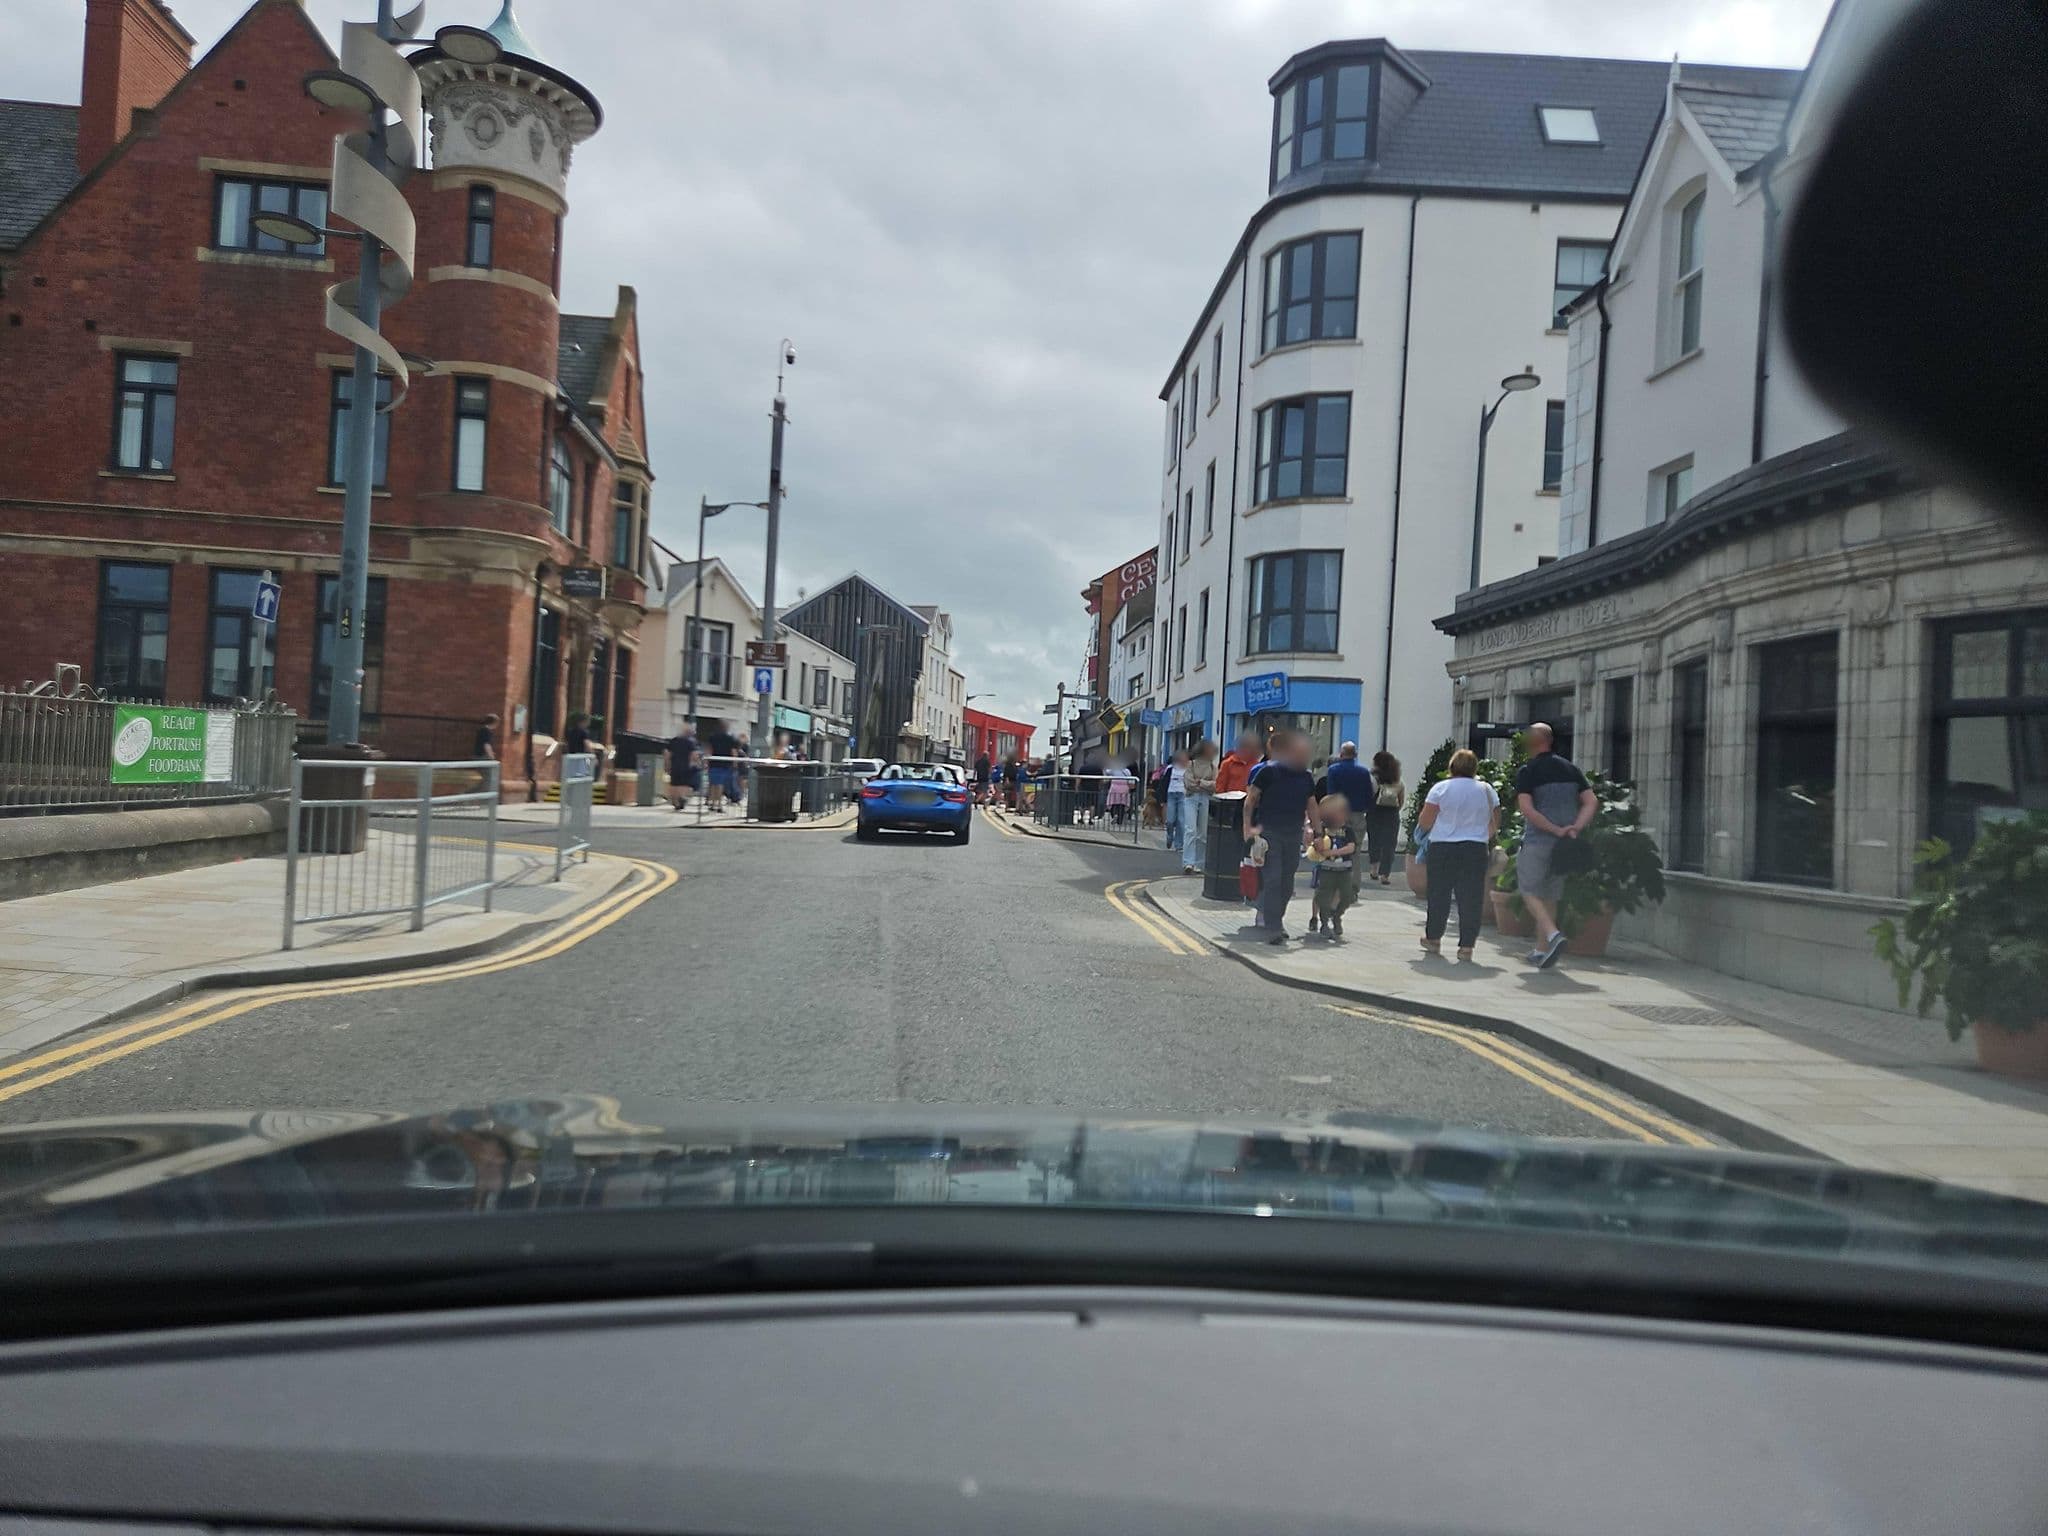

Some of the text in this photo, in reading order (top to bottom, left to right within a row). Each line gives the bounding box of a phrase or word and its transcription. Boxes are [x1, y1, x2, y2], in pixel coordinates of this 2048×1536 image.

[1480, 600, 1617, 650] LONDONDERRY HOTEL
[162, 715, 196, 730] REACH
[152, 737, 202, 752] PORTRUSH
[148, 759, 203, 773] FOODBANK
